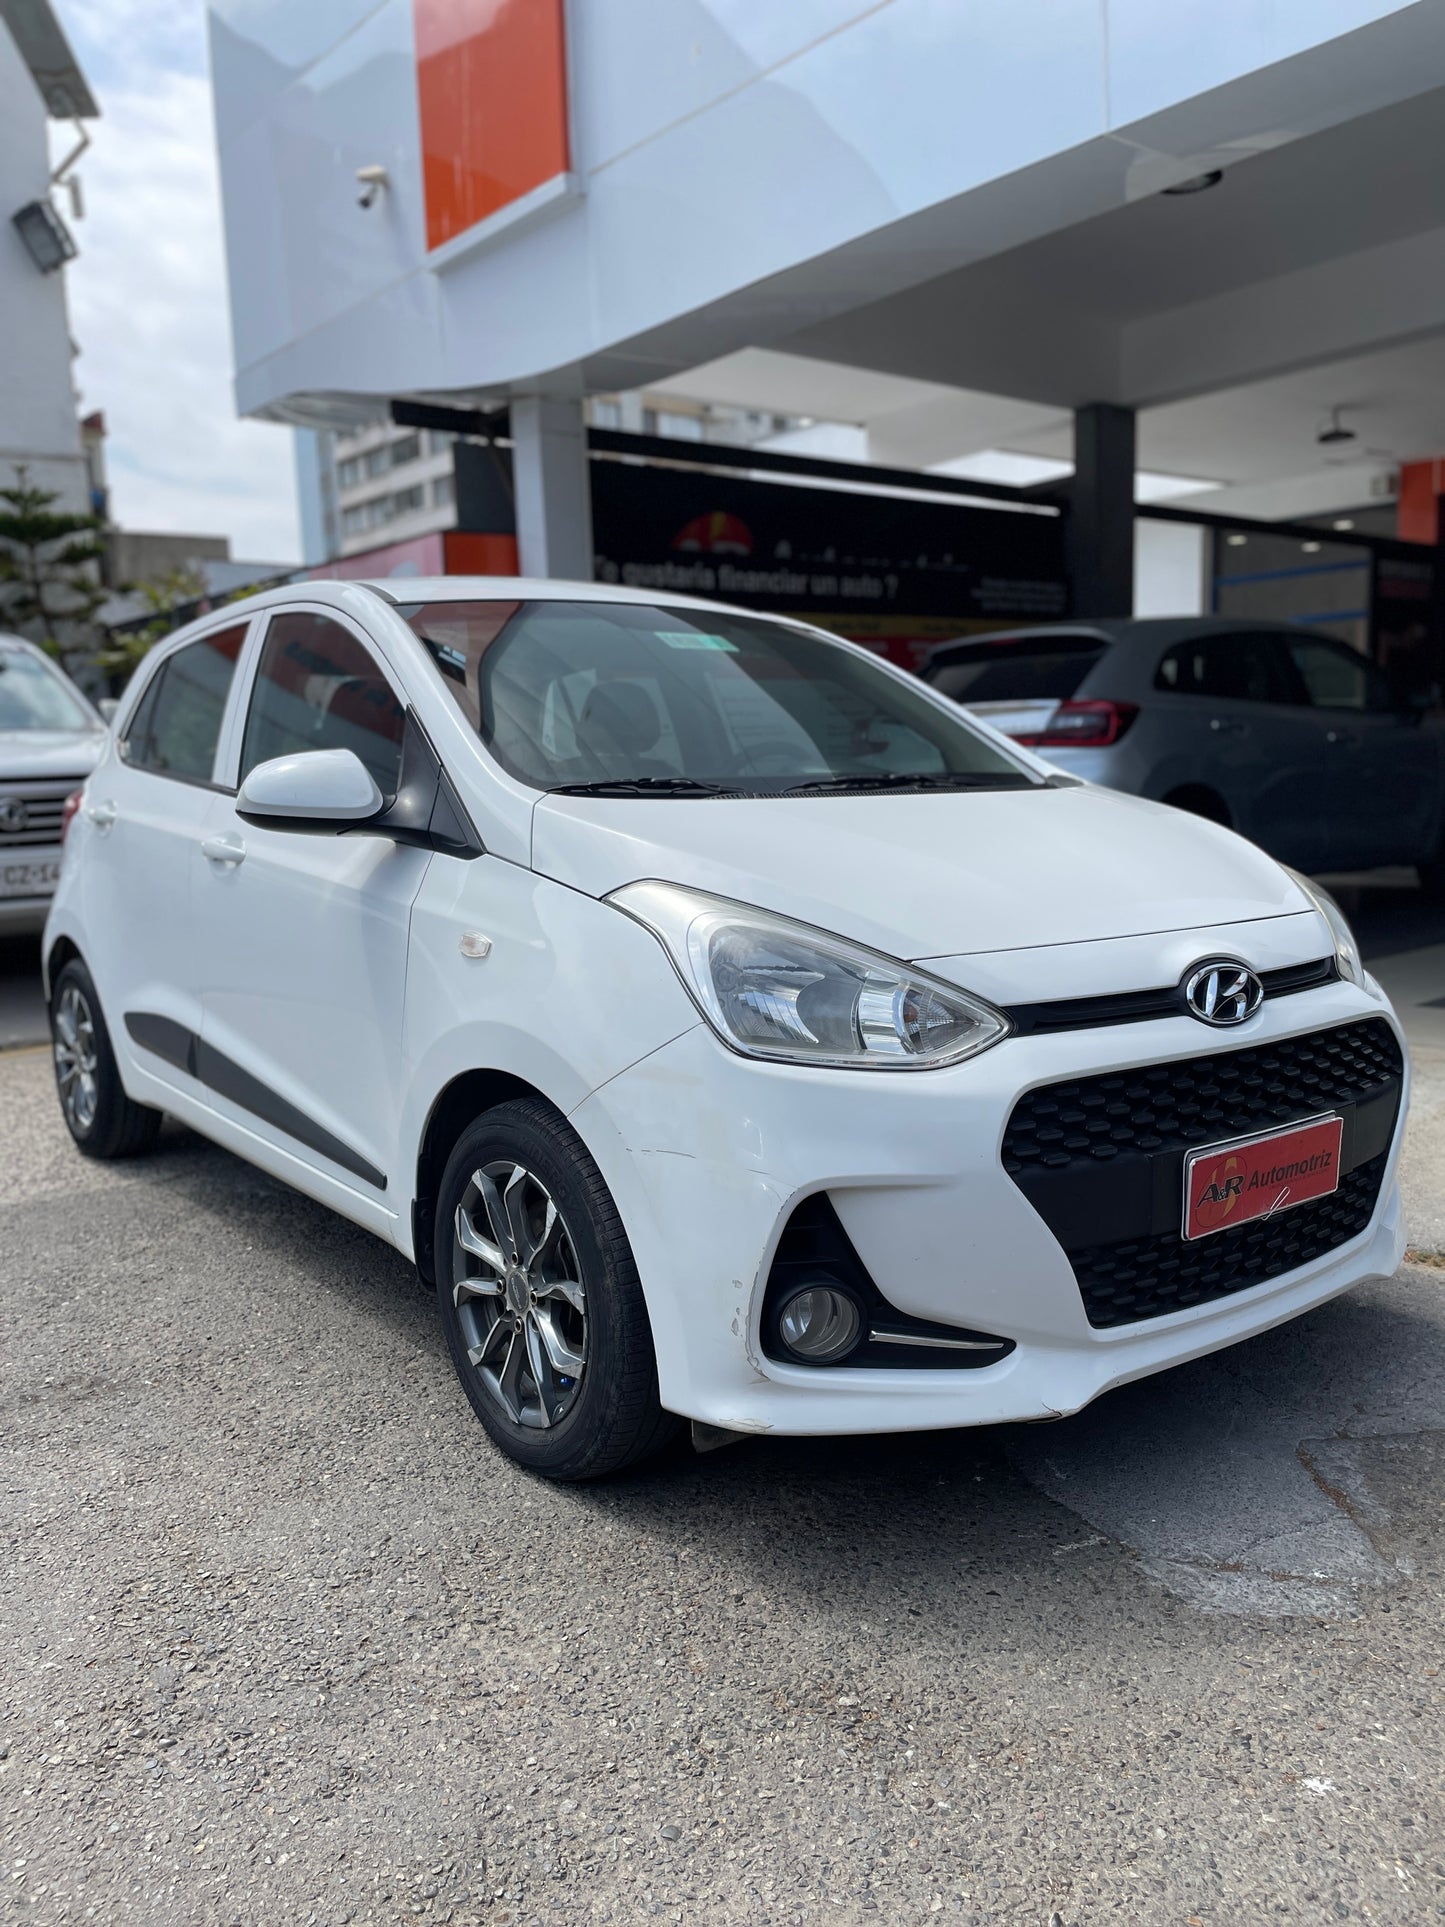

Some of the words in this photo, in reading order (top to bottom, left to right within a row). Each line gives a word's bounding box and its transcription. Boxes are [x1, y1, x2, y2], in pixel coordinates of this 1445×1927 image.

[718, 564, 808, 594] financiar
[810, 574, 838, 596] un
[839, 573, 883, 598] auto
[1196, 1174, 1245, 1209] A&R
[1247, 1149, 1333, 1192] Automotriz
